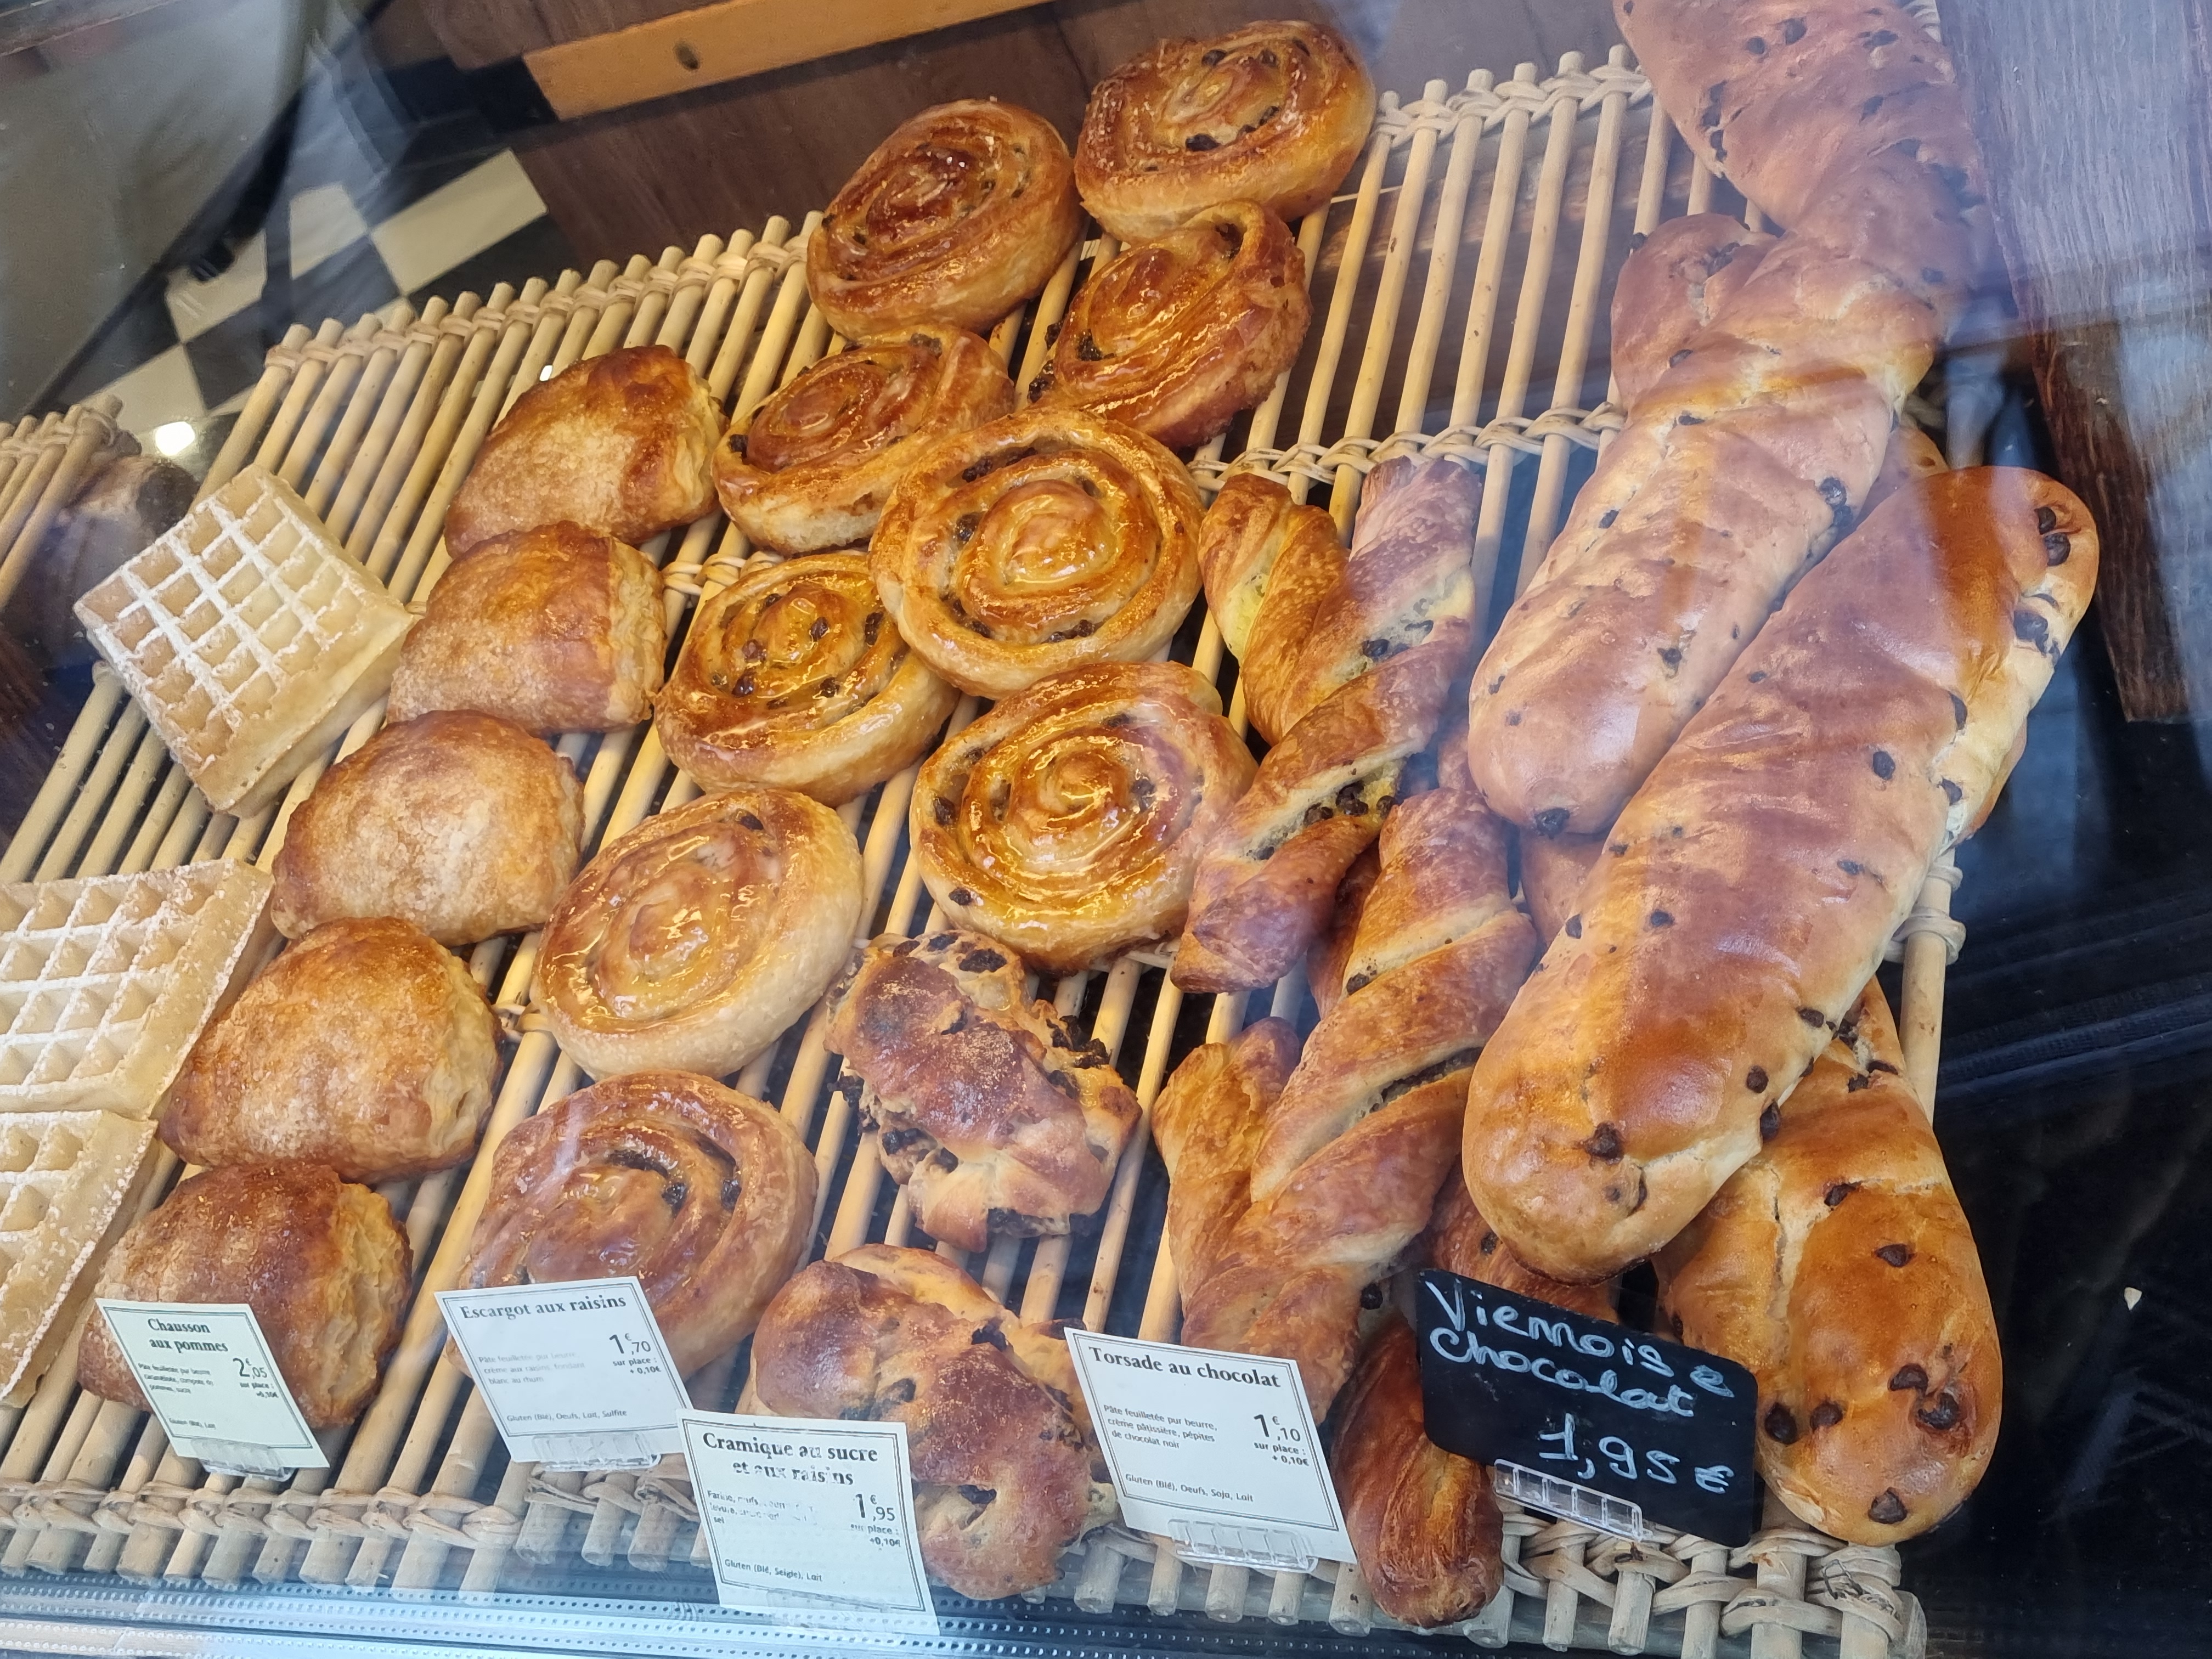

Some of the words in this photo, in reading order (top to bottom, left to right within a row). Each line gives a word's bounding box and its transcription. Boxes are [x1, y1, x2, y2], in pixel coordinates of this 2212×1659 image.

[460, 1304, 531, 1321] Escargot
[535, 1302, 566, 1314] aux
[569, 1294, 627, 1312] raisins
[148, 1318, 211, 1334] Chausson
[149, 1339, 173, 1350] aux
[173, 1340, 229, 1354] pommes
[628, 1357, 651, 1367] place
[1088, 1346, 1164, 1372] Torsade
[1168, 1362, 1193, 1375] au
[1197, 1363, 1282, 1388] chocolat
[602, 1409, 627, 1418] Sulfite
[1103, 1404, 1123, 1415] Pâte
[1124, 1408, 1165, 1423] feuilletée
[1167, 1416, 1182, 1425] pur
[1184, 1417, 1217, 1431] beurre,
[1107, 1418, 1134, 1430] crème
[1182, 1430, 1215, 1443] pépites
[1111, 1429, 1122, 1438] de
[1124, 1432, 1161, 1446] chocolat
[1163, 1440, 1180, 1449] noir
[703, 1432, 793, 1460] Cramique
[799, 1445, 822, 1459] au
[827, 1446, 879, 1462] sucre
[1254, 1442, 1269, 1451] sur
[1272, 1443, 1300, 1455] place
[732, 1460, 751, 1475] et
[1125, 1472, 1153, 1486] Gluten
[1211, 1488, 1233, 1501] Soja,
[1236, 1492, 1254, 1503] Lait
[867, 1524, 893, 1535] place
[724, 1559, 751, 1571] Gluten
[806, 1572, 823, 1582] Lait
